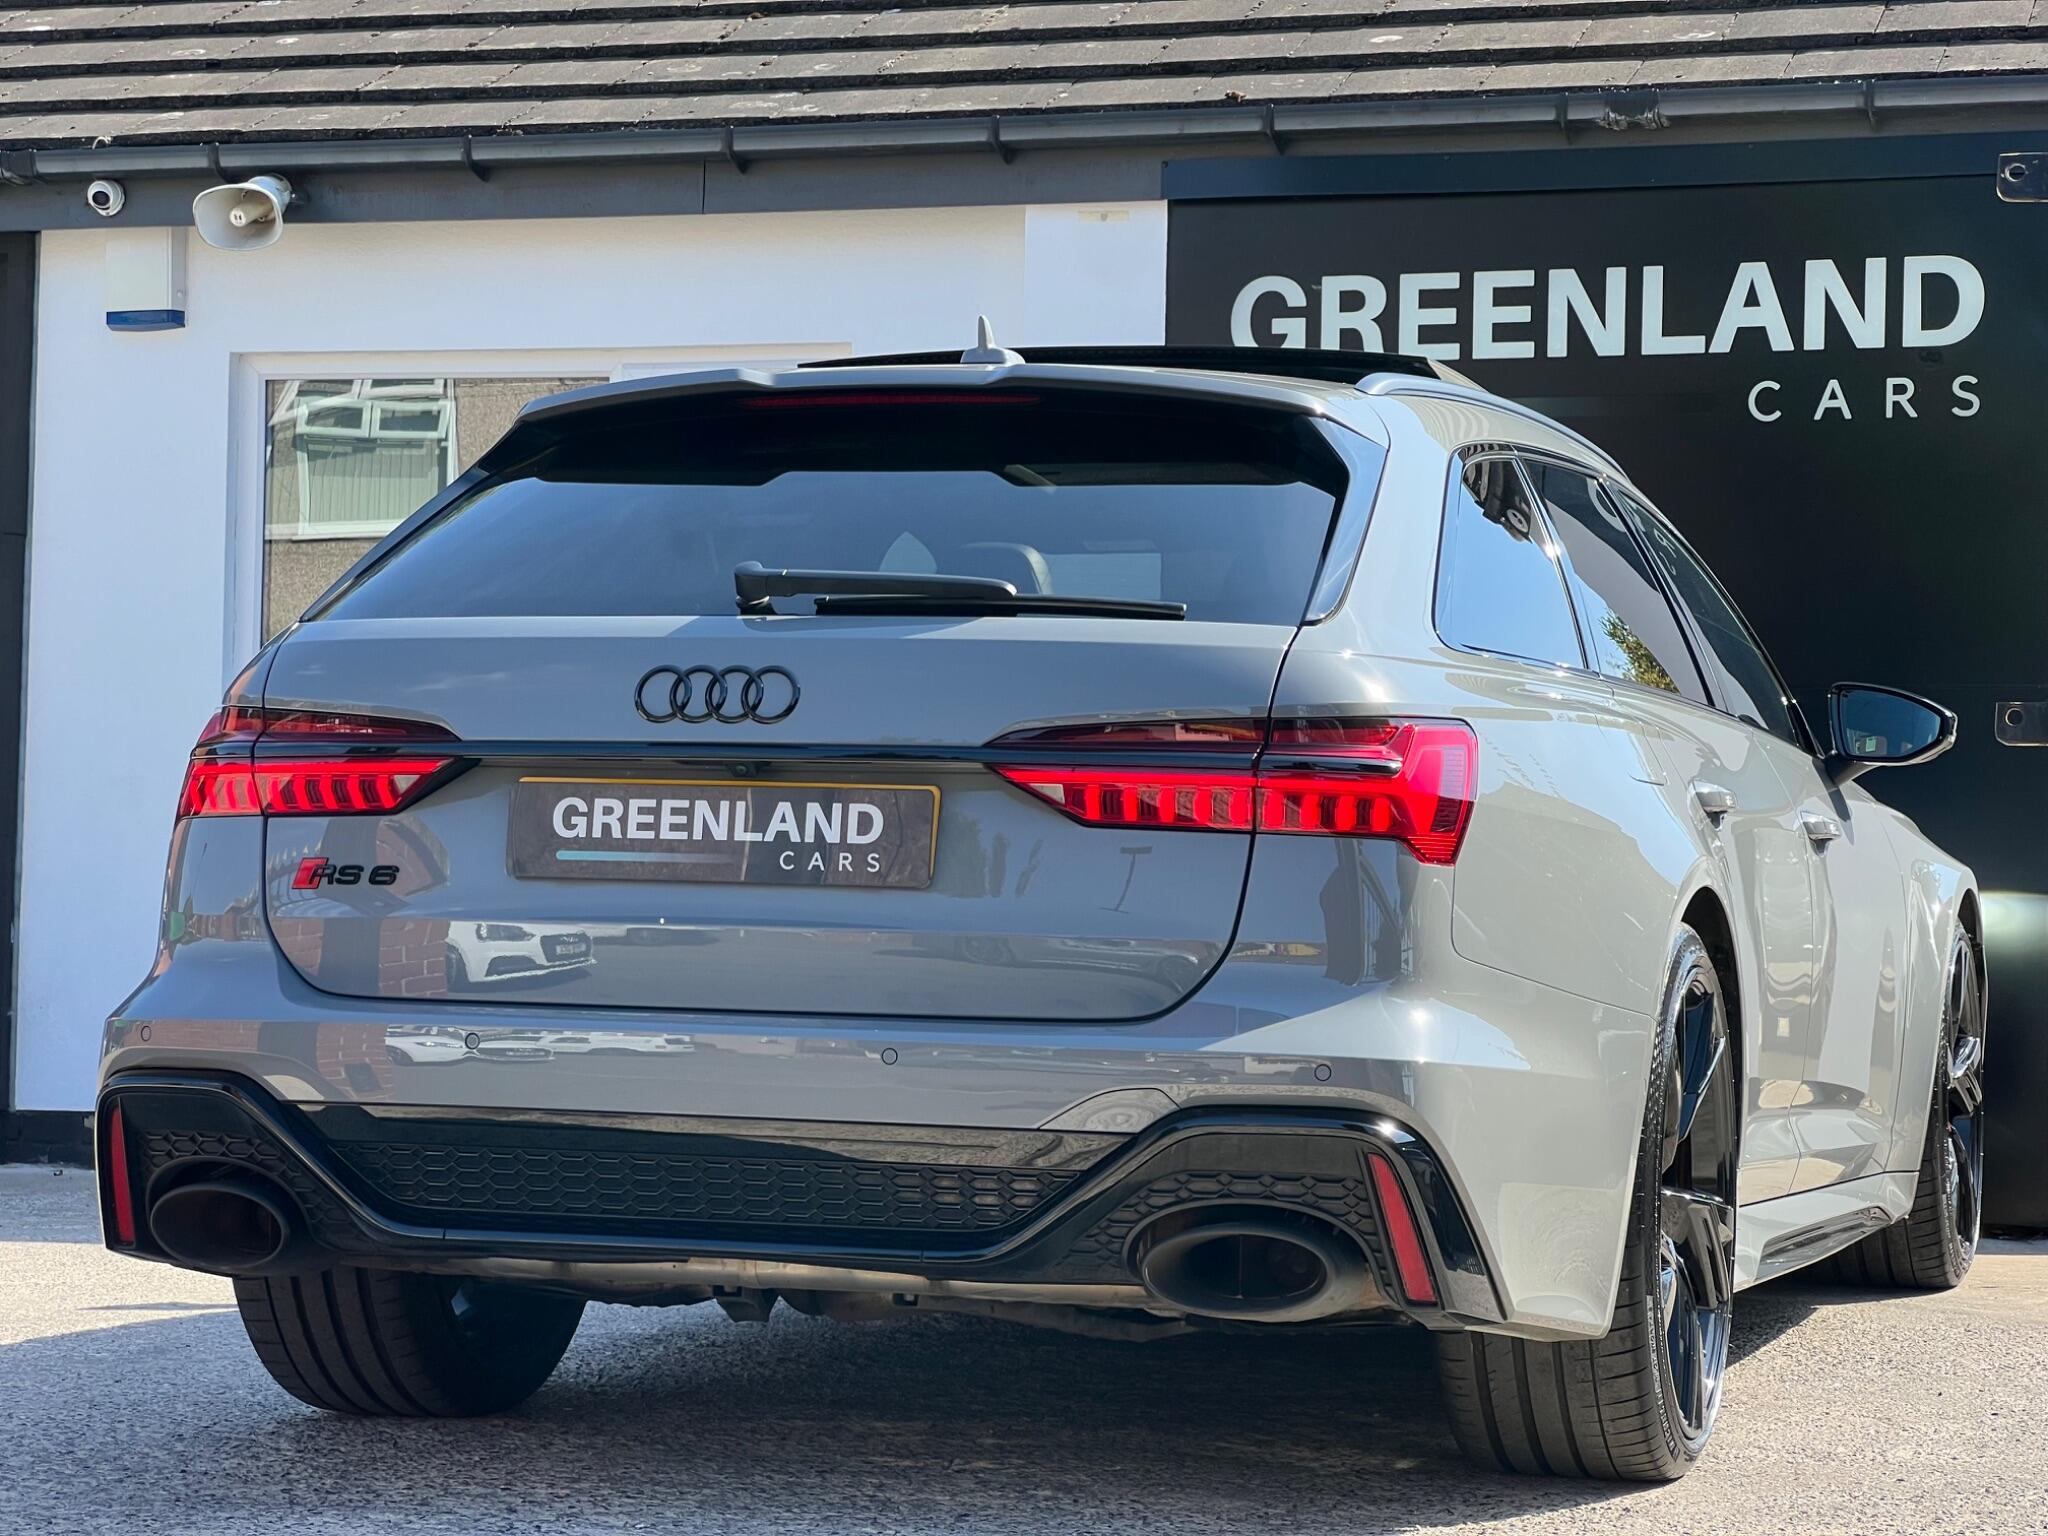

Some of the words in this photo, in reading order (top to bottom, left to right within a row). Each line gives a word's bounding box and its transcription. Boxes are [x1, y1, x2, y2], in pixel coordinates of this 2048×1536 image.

[1230, 254, 1986, 360] GREENLAND
[1747, 374, 1981, 422] CARS
[552, 796, 885, 845] GREENLAND
[779, 850, 881, 872] CARS
